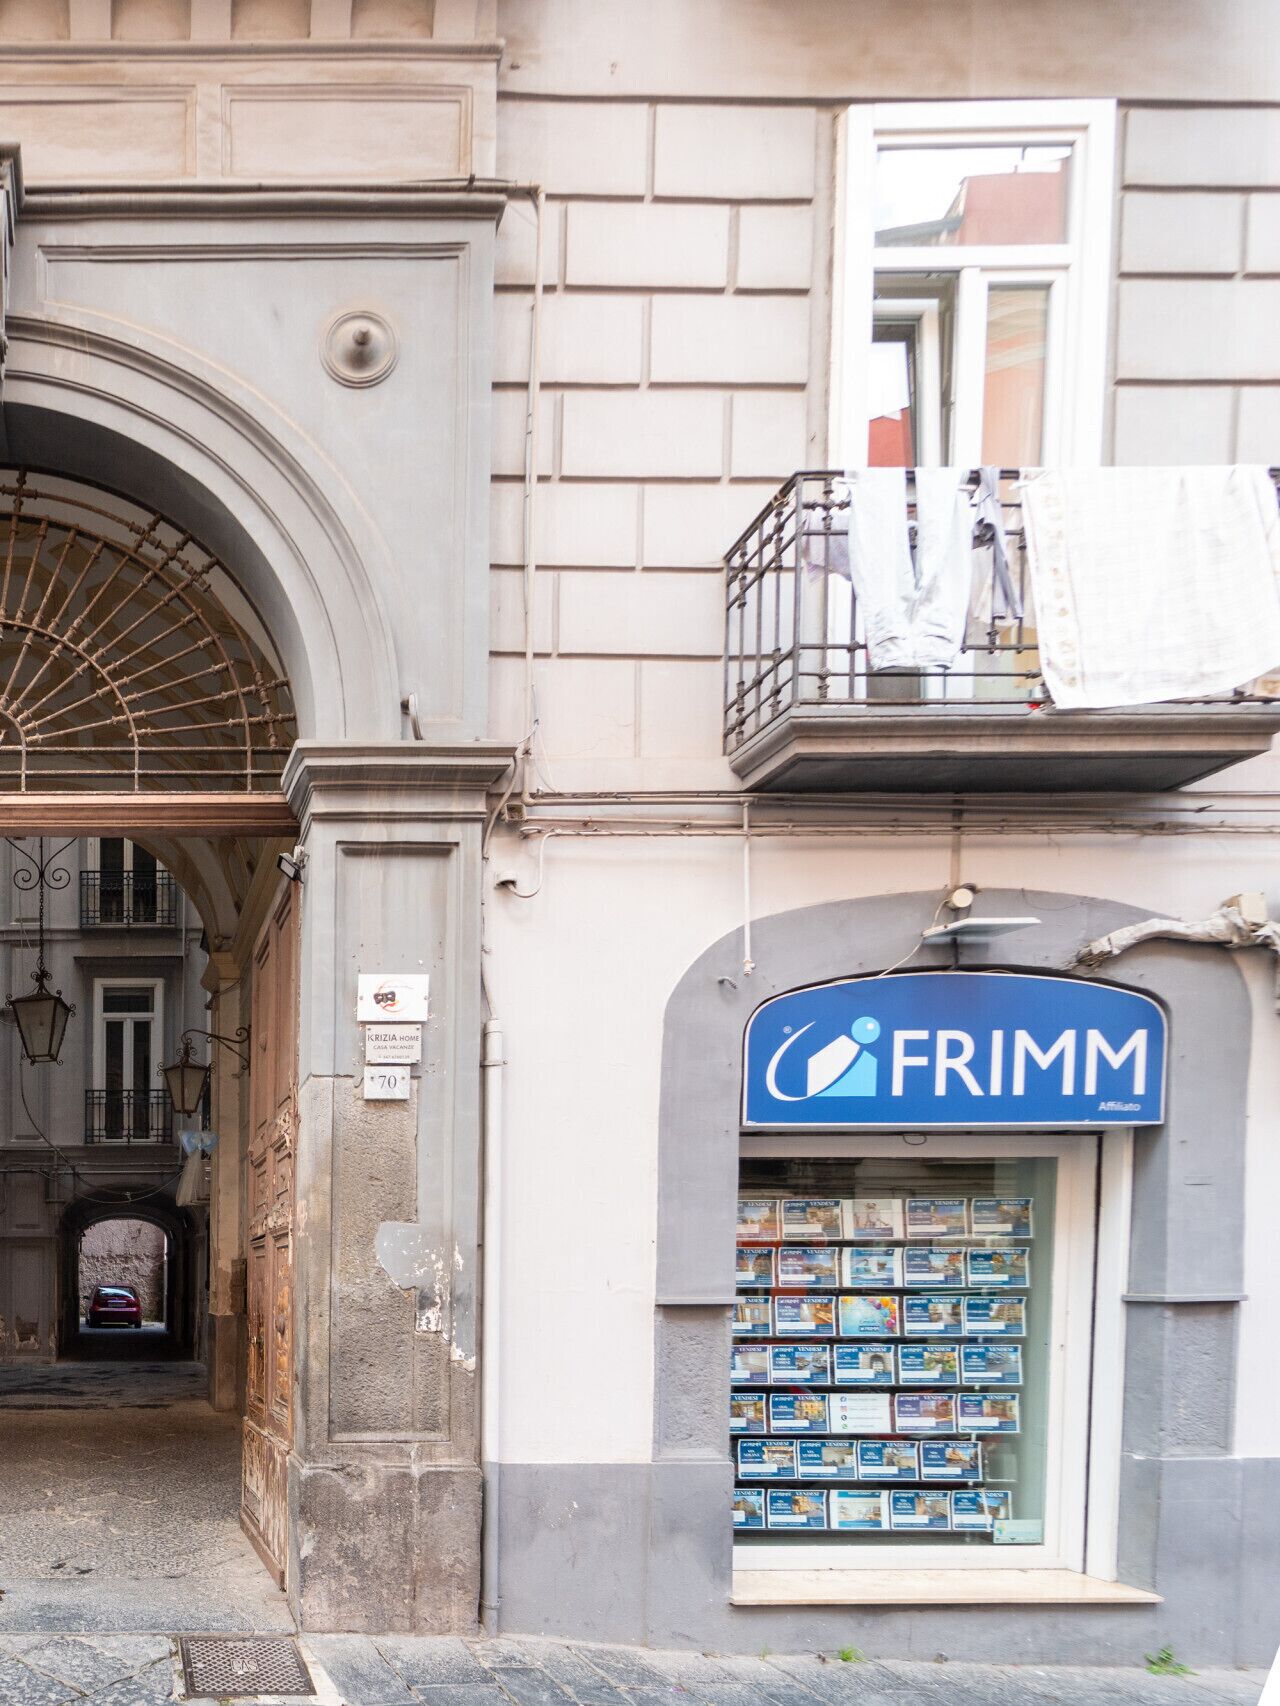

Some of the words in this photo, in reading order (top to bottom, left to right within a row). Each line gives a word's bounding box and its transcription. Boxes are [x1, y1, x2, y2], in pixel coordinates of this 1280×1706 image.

[367, 1034, 398, 1042] KRIZIA
[891, 1029, 1148, 1097] FRIMM
[378, 1075, 397, 1089] 70
[1099, 1101, 1141, 1111] Affiliato
